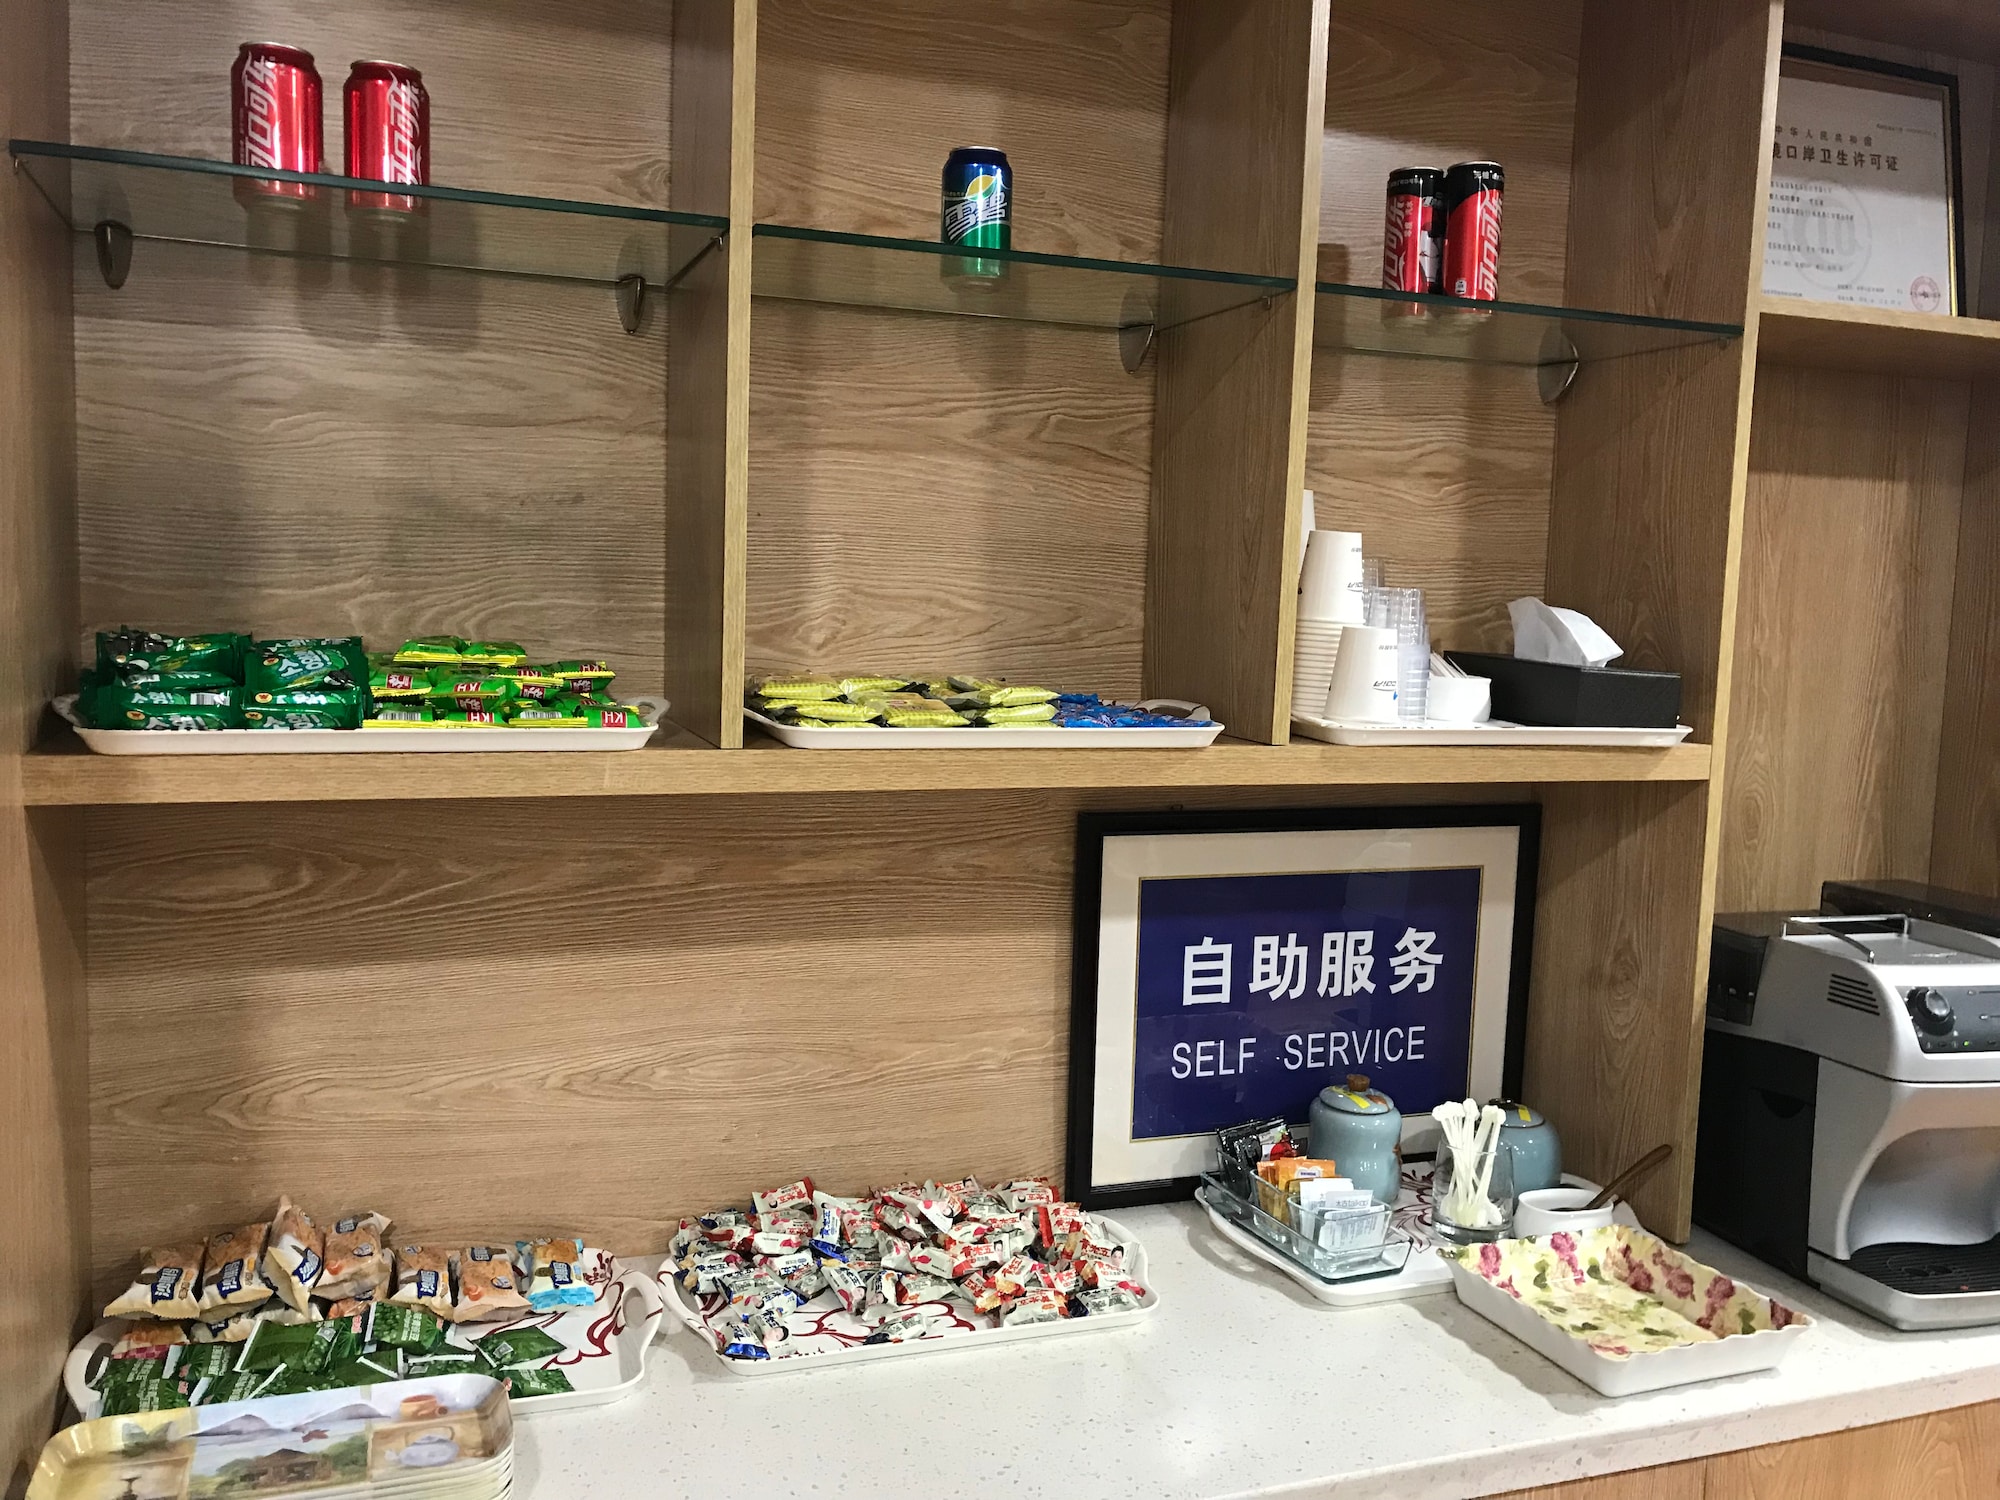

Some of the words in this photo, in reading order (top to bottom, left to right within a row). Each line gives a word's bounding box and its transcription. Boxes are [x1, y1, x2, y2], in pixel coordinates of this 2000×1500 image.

[945, 191, 1008, 240] 雪碧
[1181, 926, 1444, 1007] 自助服务
[1170, 1037, 1257, 1079] SELF
[1283, 1025, 1427, 1071] SERVICE
